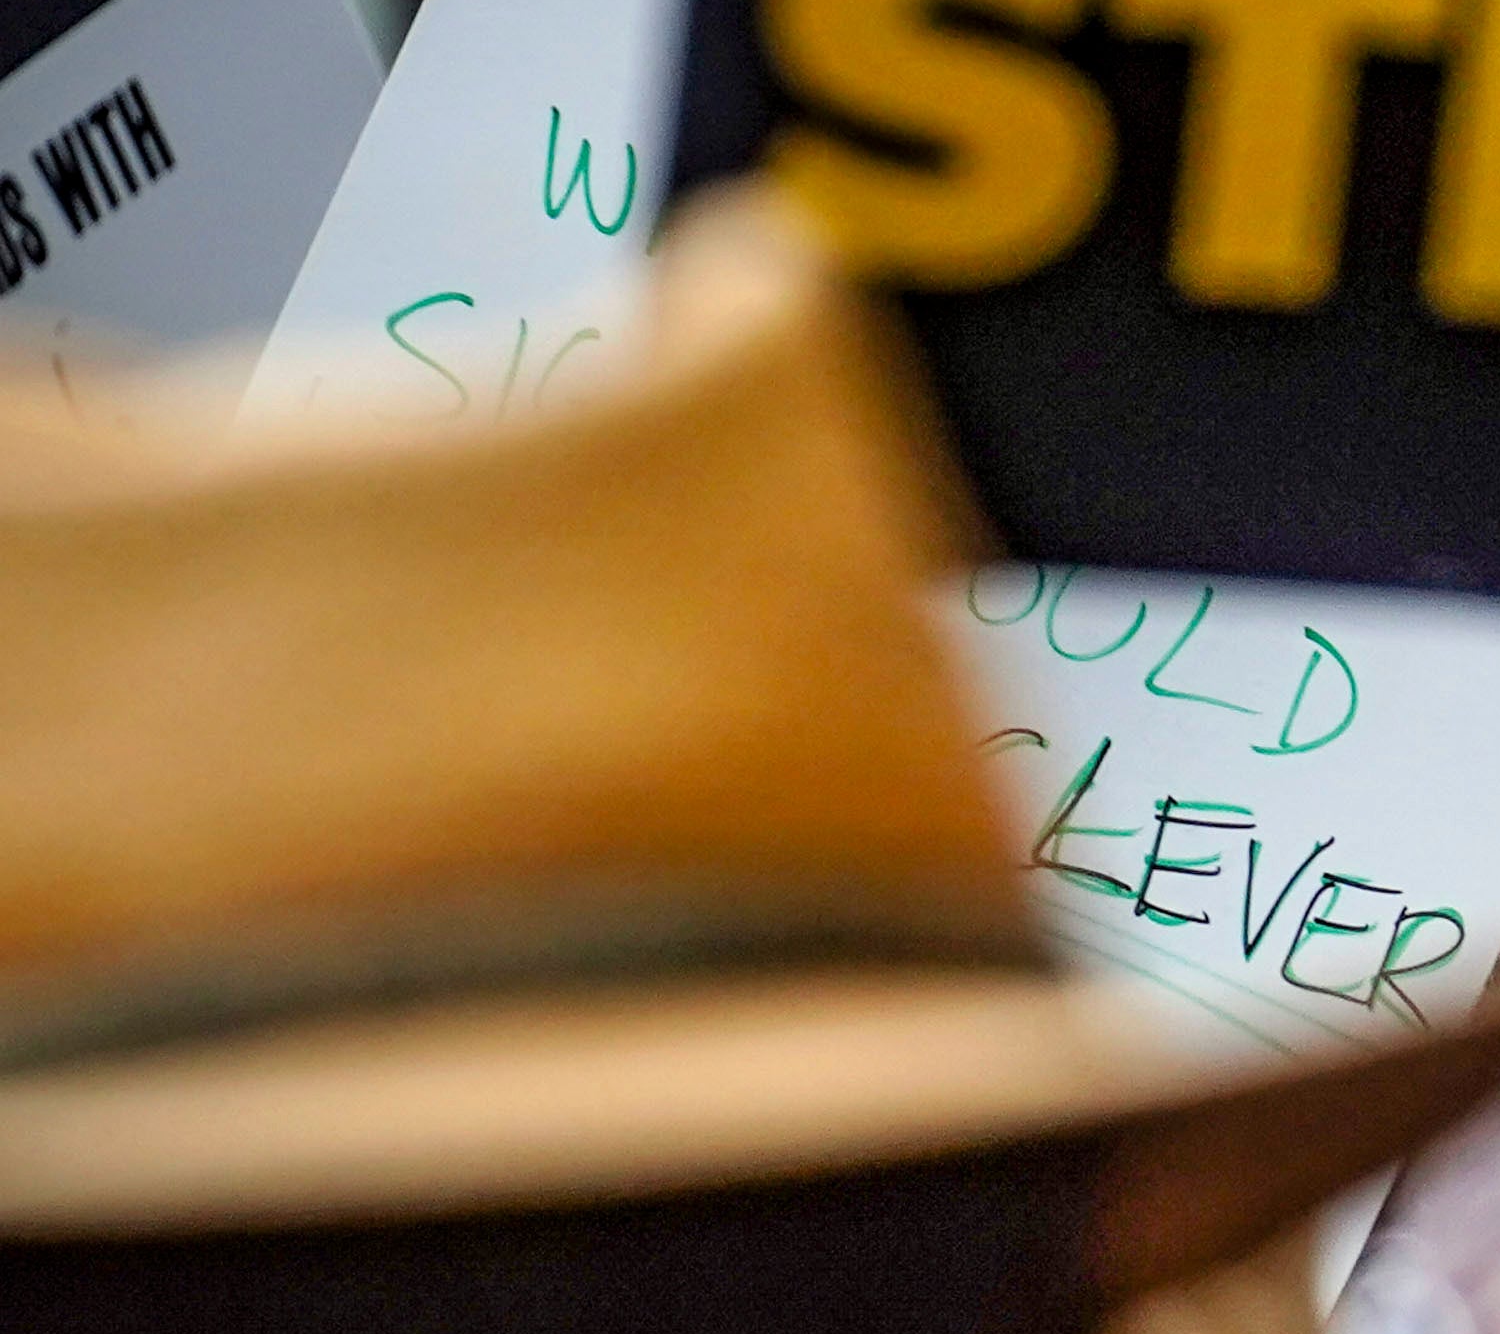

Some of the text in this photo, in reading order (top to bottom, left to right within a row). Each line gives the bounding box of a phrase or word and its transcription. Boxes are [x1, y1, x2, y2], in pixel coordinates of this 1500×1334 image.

[30, 75, 177, 239] WITH
[966, 563, 1360, 755] OULD
[980, 725, 1466, 1031] LEVER
